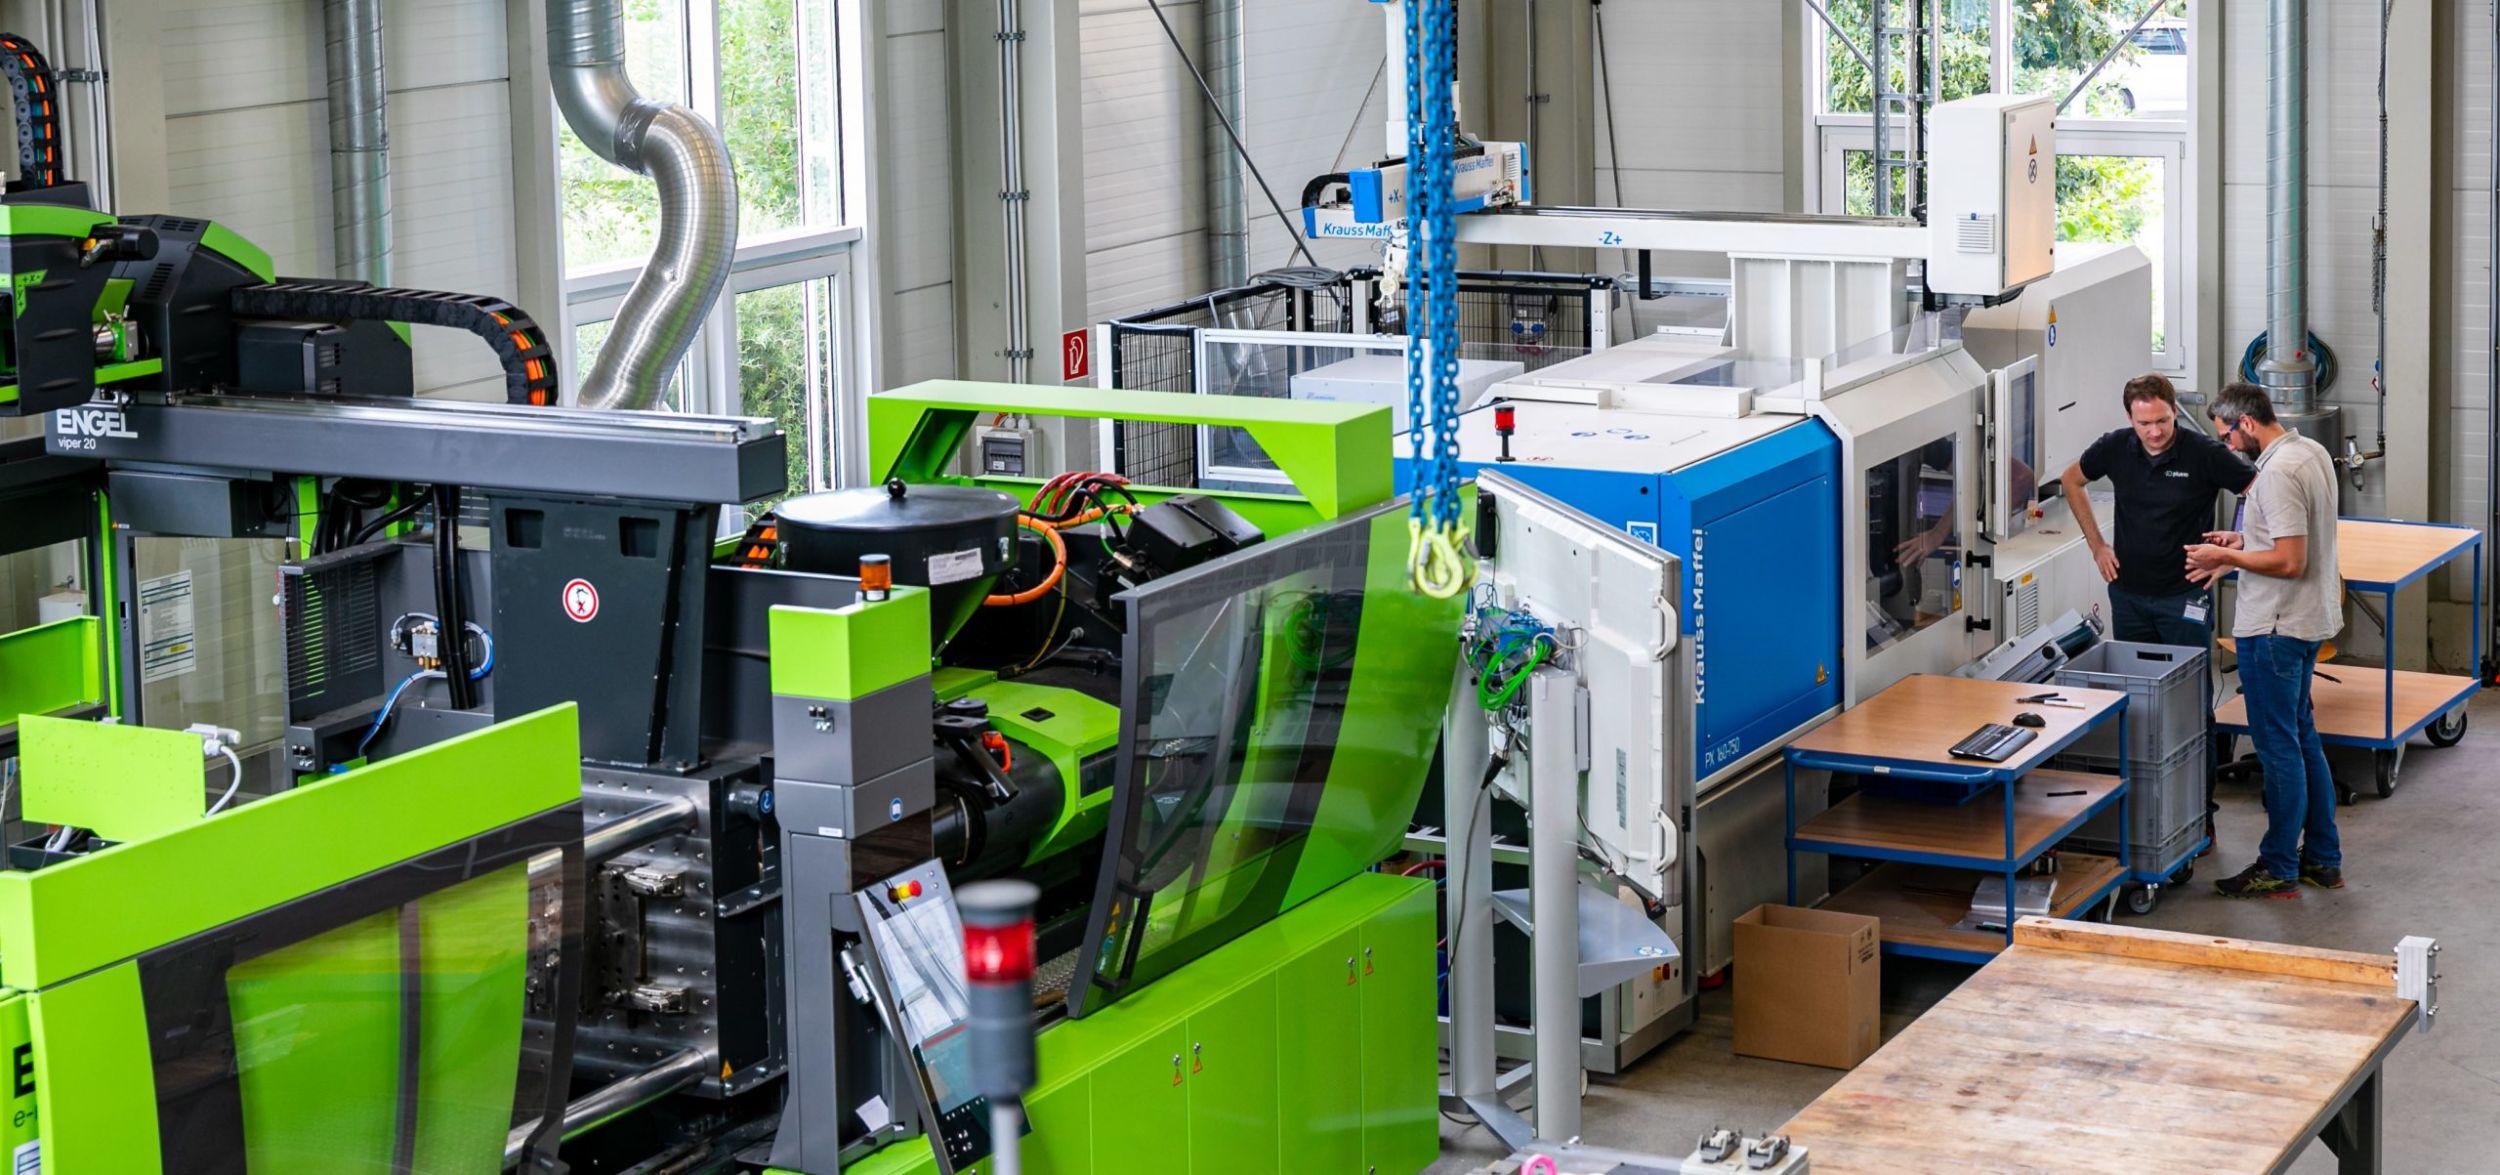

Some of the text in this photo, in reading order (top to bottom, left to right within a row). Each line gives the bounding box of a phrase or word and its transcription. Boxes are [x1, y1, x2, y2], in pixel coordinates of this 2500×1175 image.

[1365, 224, 1393, 237] Maff
[1598, 231, 1622, 245] -Z+
[56, 408, 138, 439] ENGEL
[57, 436, 96, 450] viper 20
[1705, 749, 1715, 769] PX
